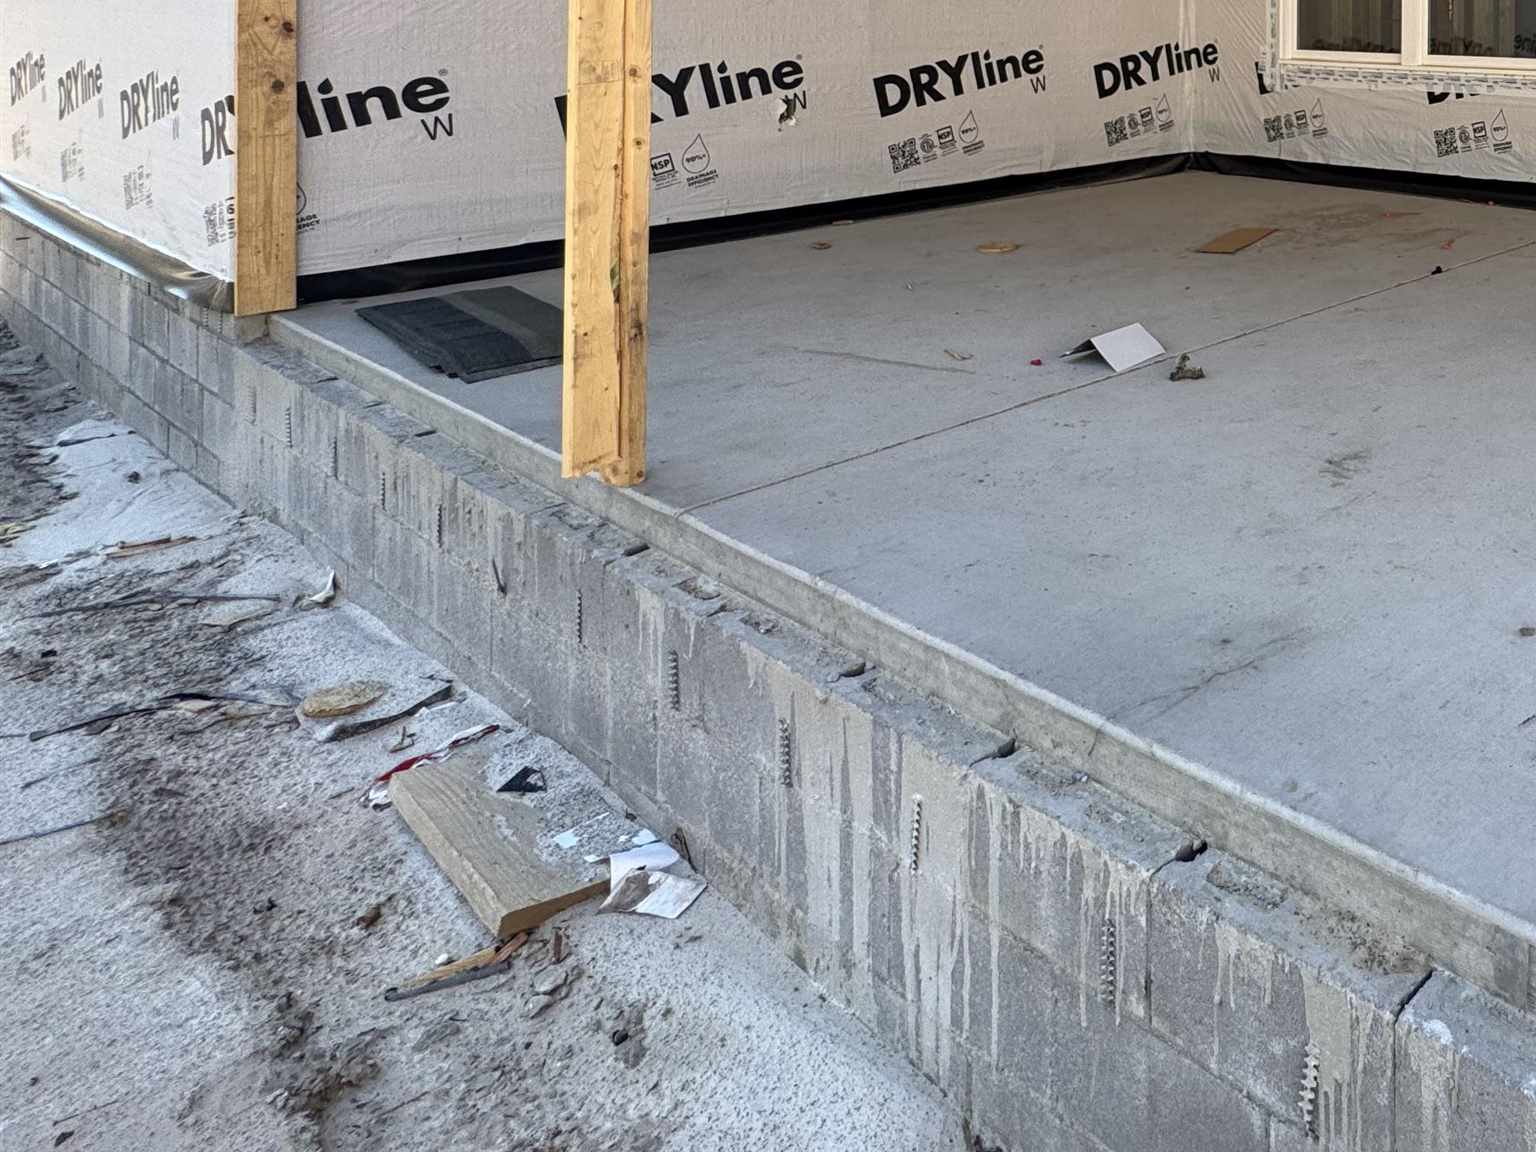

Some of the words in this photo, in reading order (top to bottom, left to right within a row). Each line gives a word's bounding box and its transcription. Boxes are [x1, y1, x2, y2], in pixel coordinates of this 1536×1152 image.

[9, 50, 46, 107] DRYline
[57, 58, 104, 121] DRYline
[872, 47, 1046, 118] DRYline
[1029, 75, 1047, 95] W
[1092, 41, 1220, 100] DRYline
[119, 70, 180, 140] DRYline
